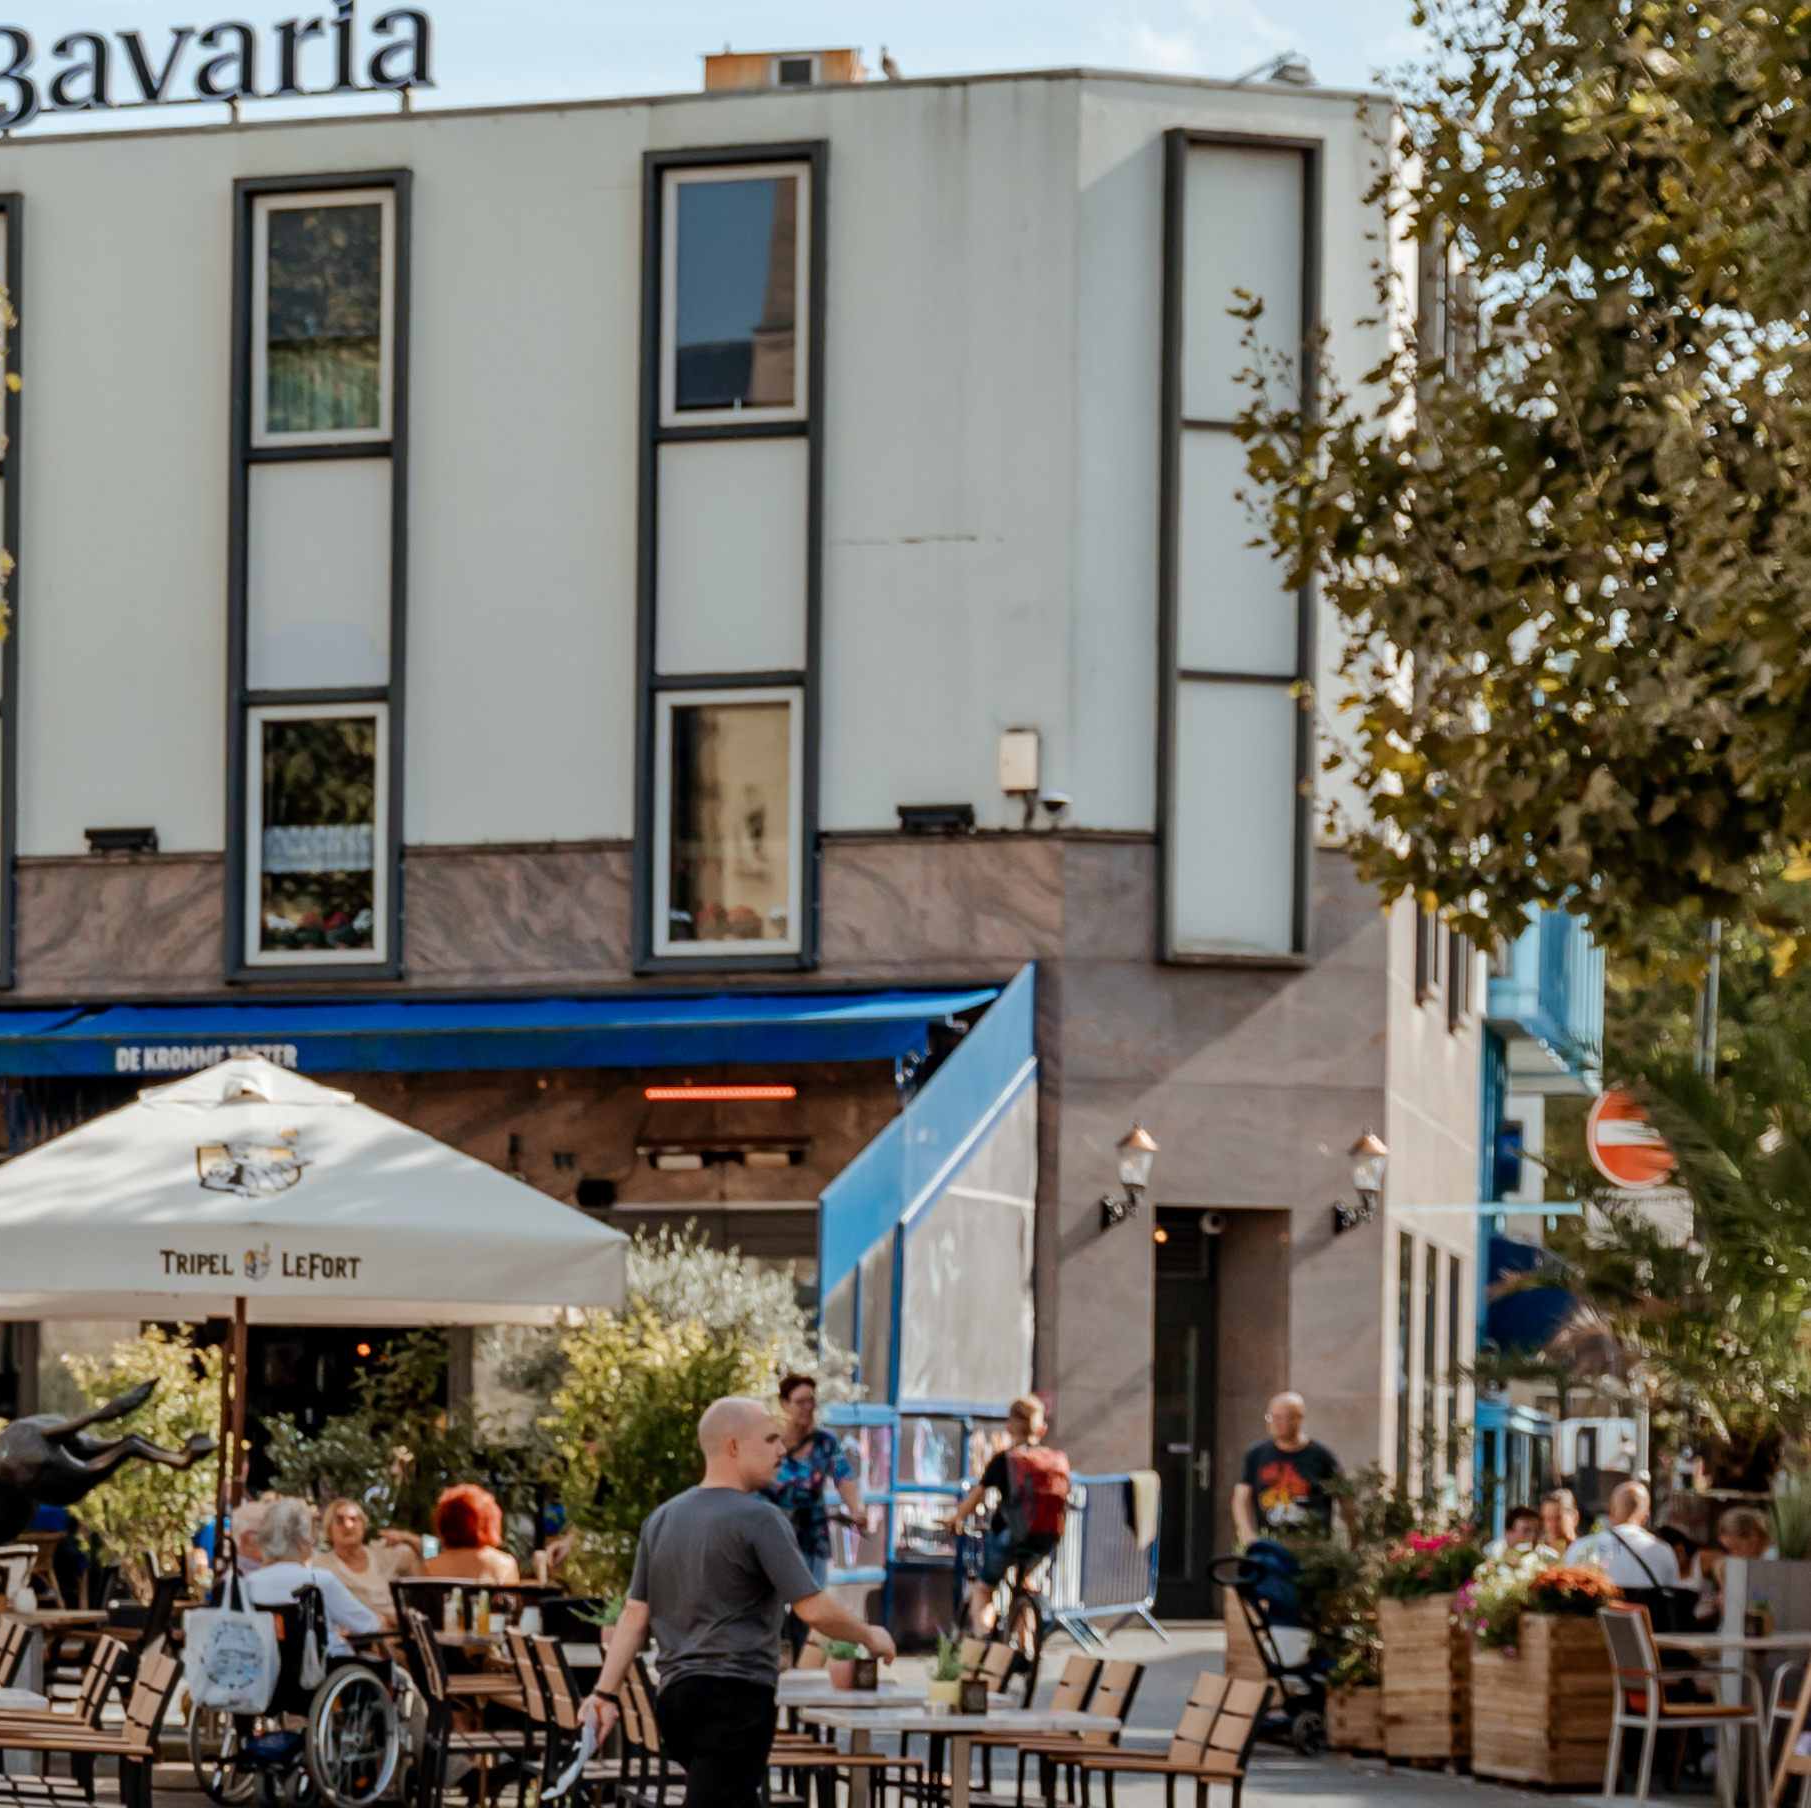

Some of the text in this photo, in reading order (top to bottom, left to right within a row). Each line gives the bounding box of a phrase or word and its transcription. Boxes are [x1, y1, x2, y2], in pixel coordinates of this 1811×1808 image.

[115, 1047, 141, 1072] DE
[160, 1250, 362, 1281] TRIPEL LEFORT
